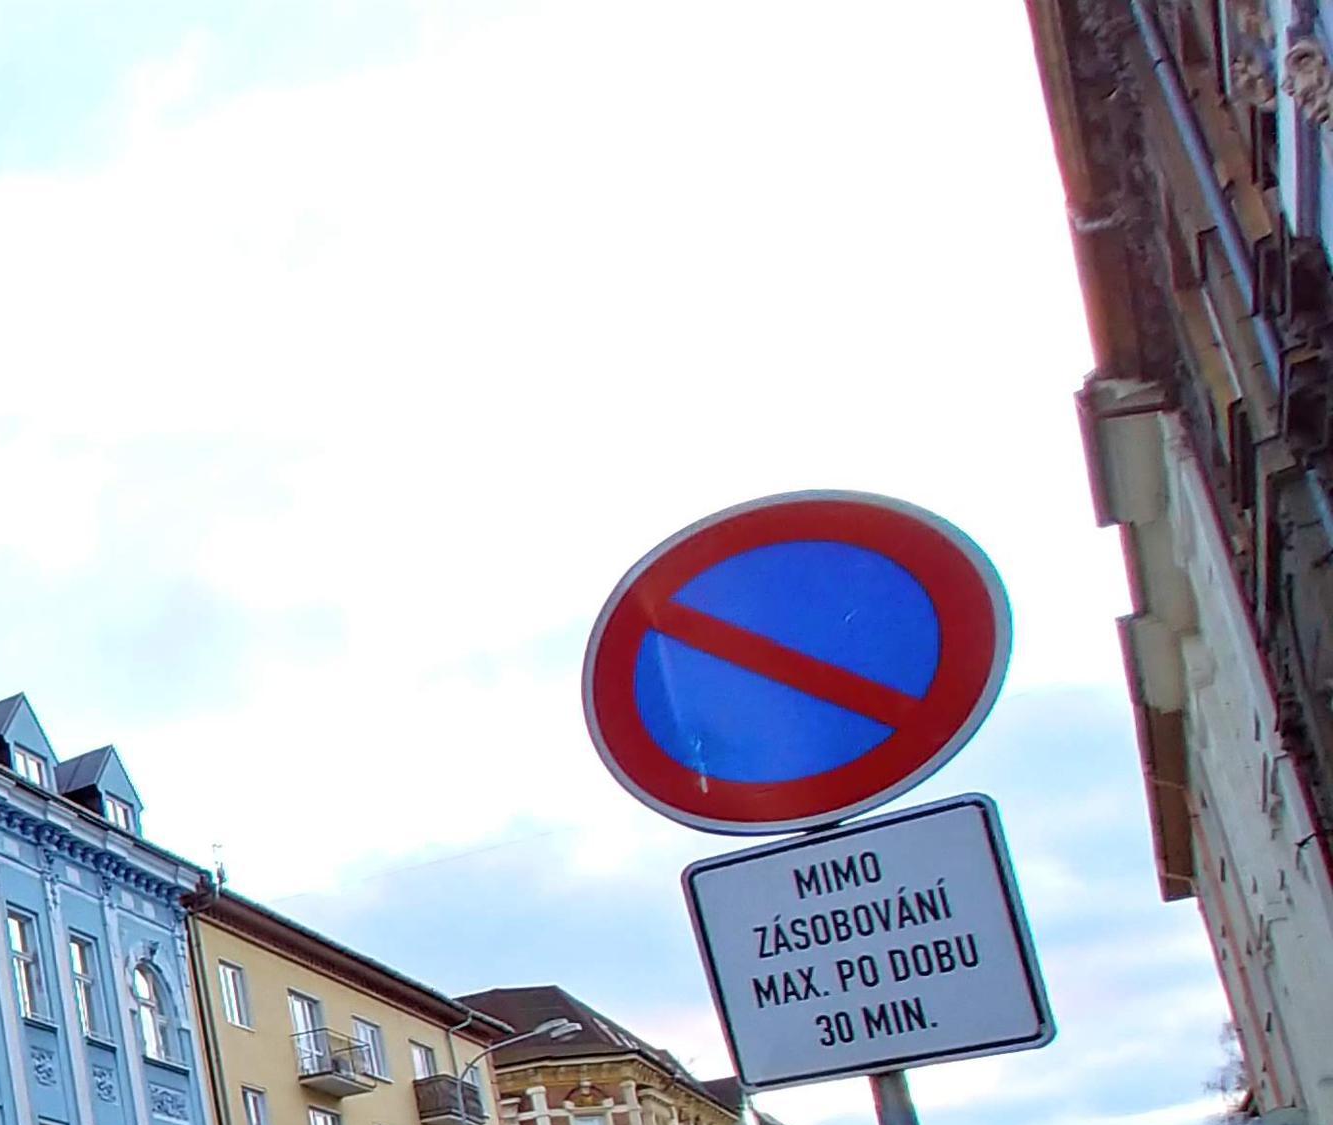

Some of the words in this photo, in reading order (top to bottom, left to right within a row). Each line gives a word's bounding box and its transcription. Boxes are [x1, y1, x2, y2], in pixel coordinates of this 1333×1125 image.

[794, 851, 882, 899] MIMO
[753, 878, 953, 958] ZÁSOBOVÁNÍ
[752, 966, 829, 1009] MAX.
[835, 955, 879, 993] PO
[888, 933, 980, 983] DOBU
[815, 1011, 855, 1047] 30
[862, 997, 938, 1039] MIN.
